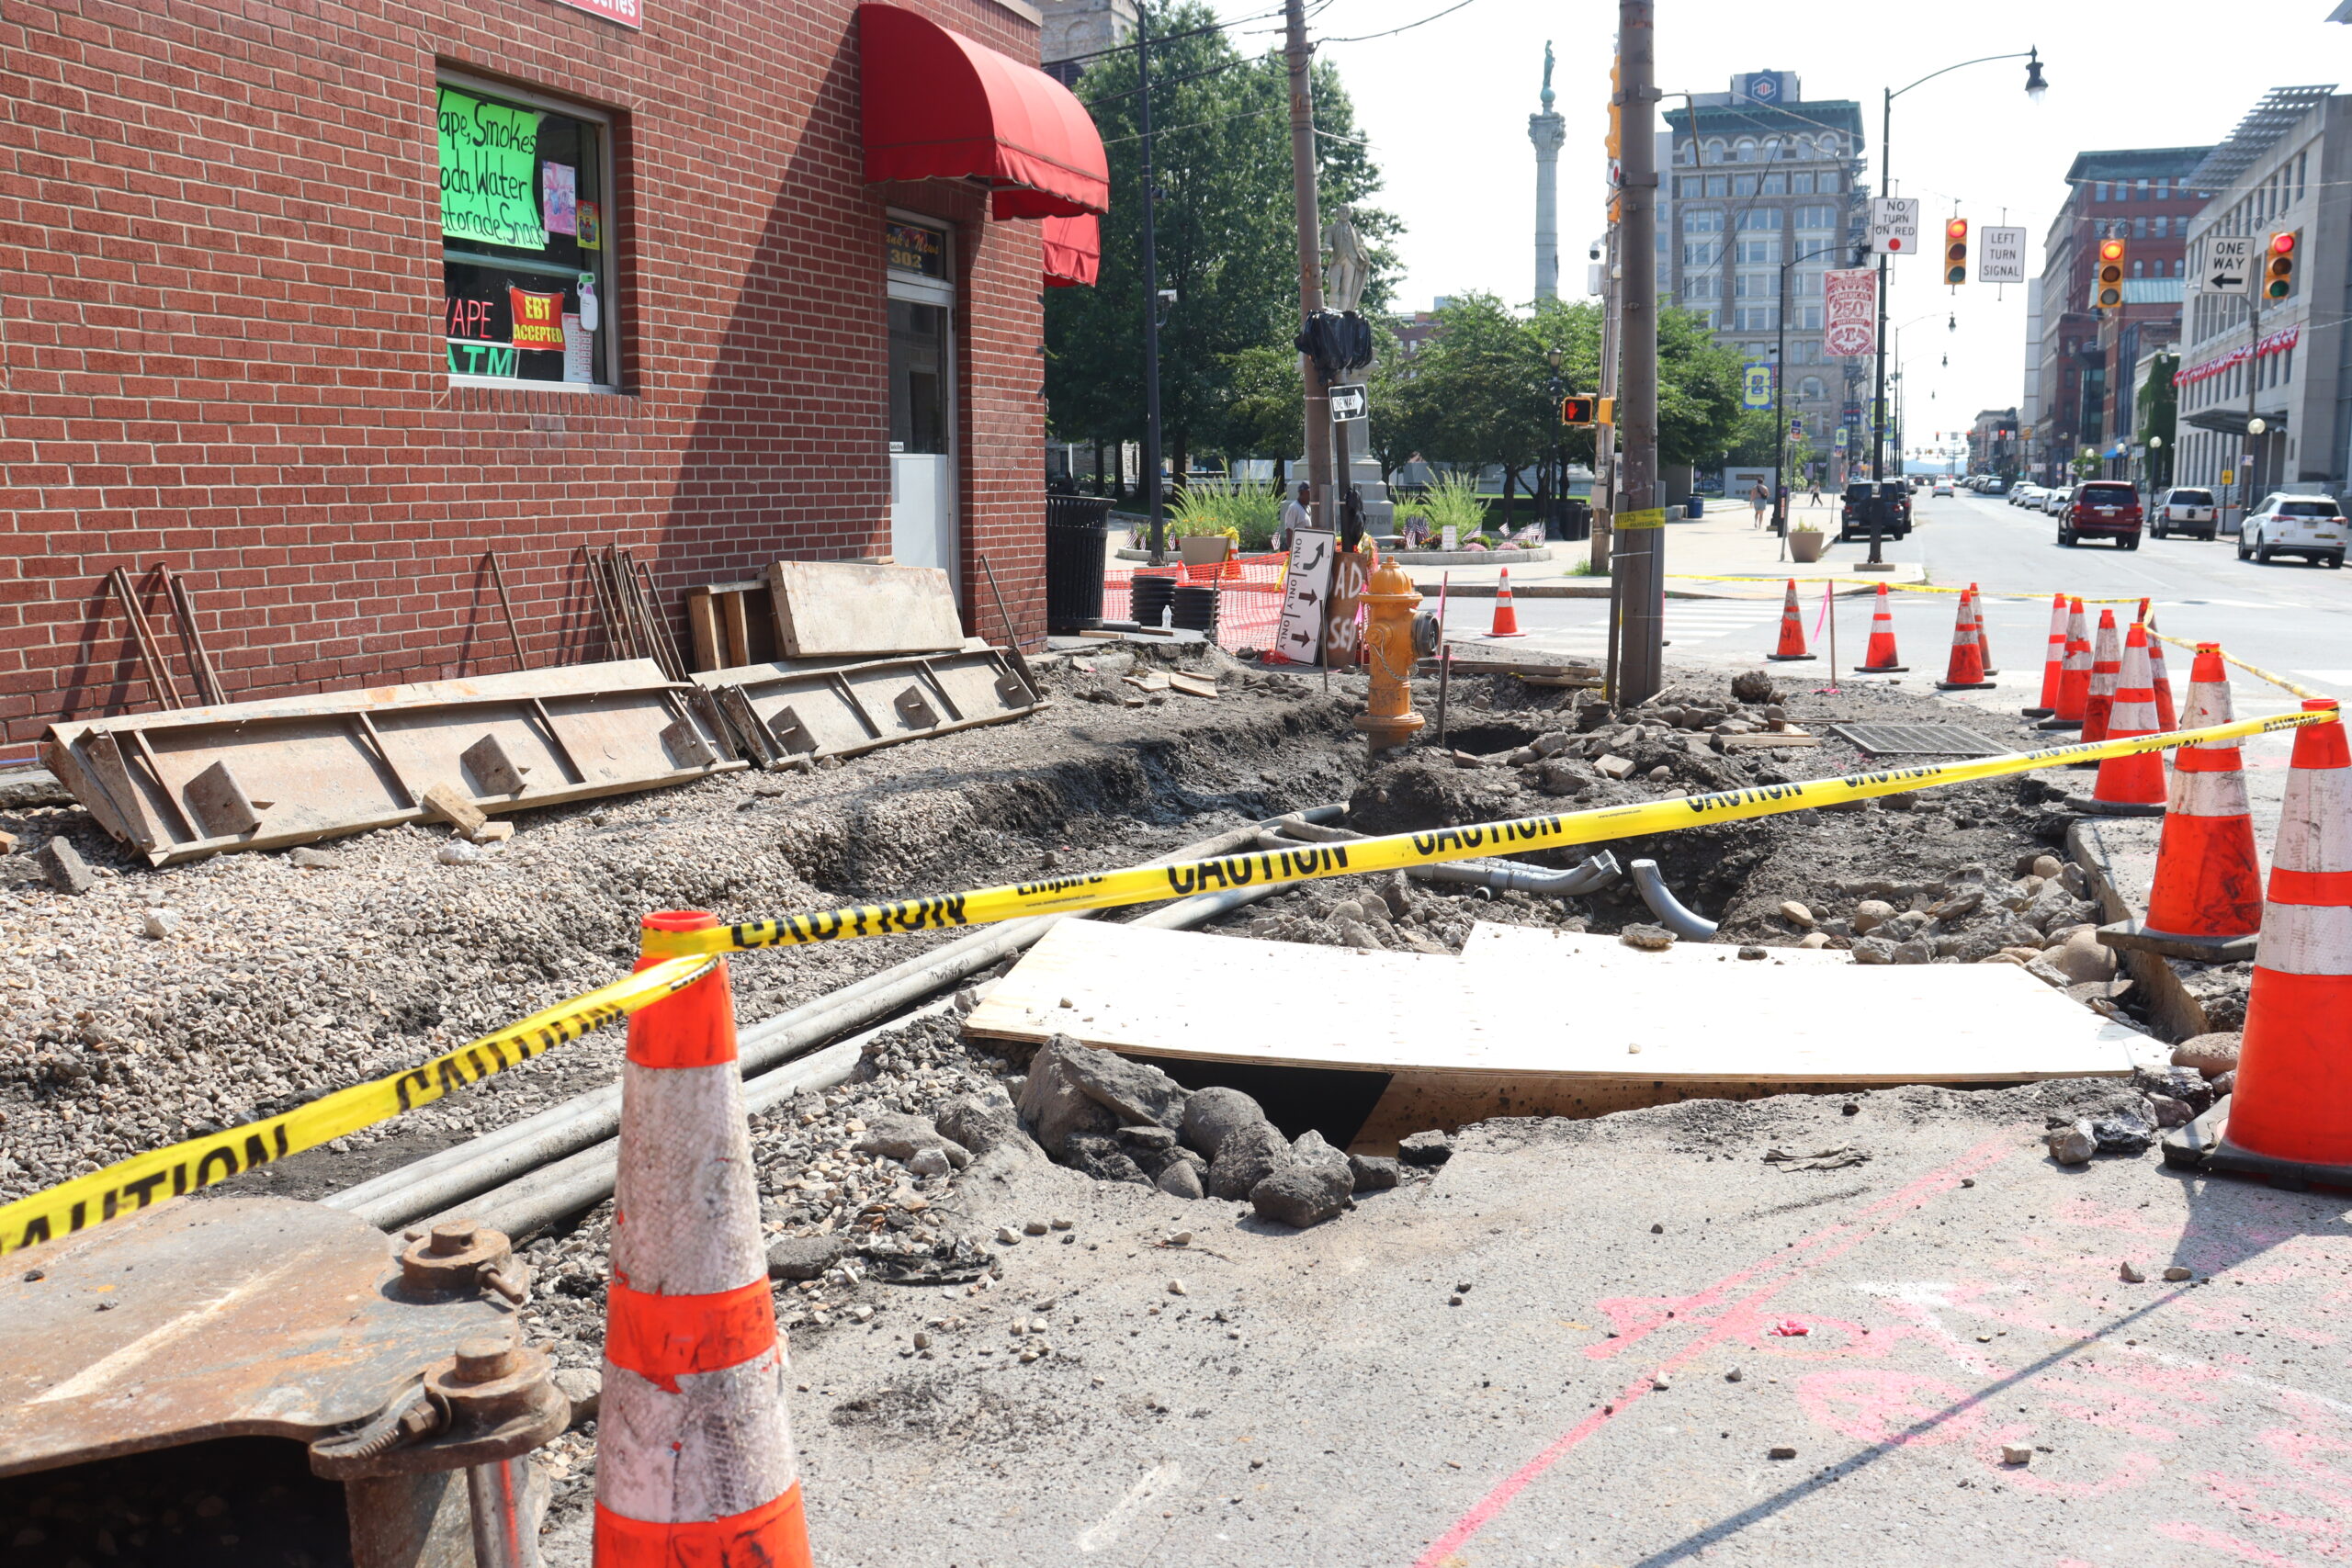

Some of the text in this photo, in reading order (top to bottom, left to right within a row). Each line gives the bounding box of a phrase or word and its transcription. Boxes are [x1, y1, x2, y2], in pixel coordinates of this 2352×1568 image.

[472, 103, 537, 154] Smokes
[440, 148, 527, 203] oda, Water
[441, 194, 506, 240] atorade,
[1887, 201, 1905, 211] NO
[1883, 214, 1909, 223] TURN
[1875, 226, 1916, 236] ON RED
[1991, 233, 2015, 243] LEFT
[891, 249, 922, 268] 302
[1990, 249, 2017, 260] TURN
[2216, 242, 2245, 254] ONE
[1984, 265, 2019, 276] SIGNAL
[2213, 257, 2245, 270] WAY
[525, 296, 551, 320] EBT
[1833, 300, 1864, 319] 250
[514, 323, 563, 343] ACCEPTED
[1343, 395, 1356, 409] WAY
[1294, 538, 1303, 569] ONLY
[1287, 579, 1297, 610] ONLY
[1279, 620, 1291, 650] ONLY
[1685, 782, 1803, 812] CAUTION
[1412, 815, 1562, 855] CAUTION
[1168, 844, 1349, 894] CAUTION
[731, 893, 968, 949] CAUTION
[15, 1122, 289, 1249] AUTION
